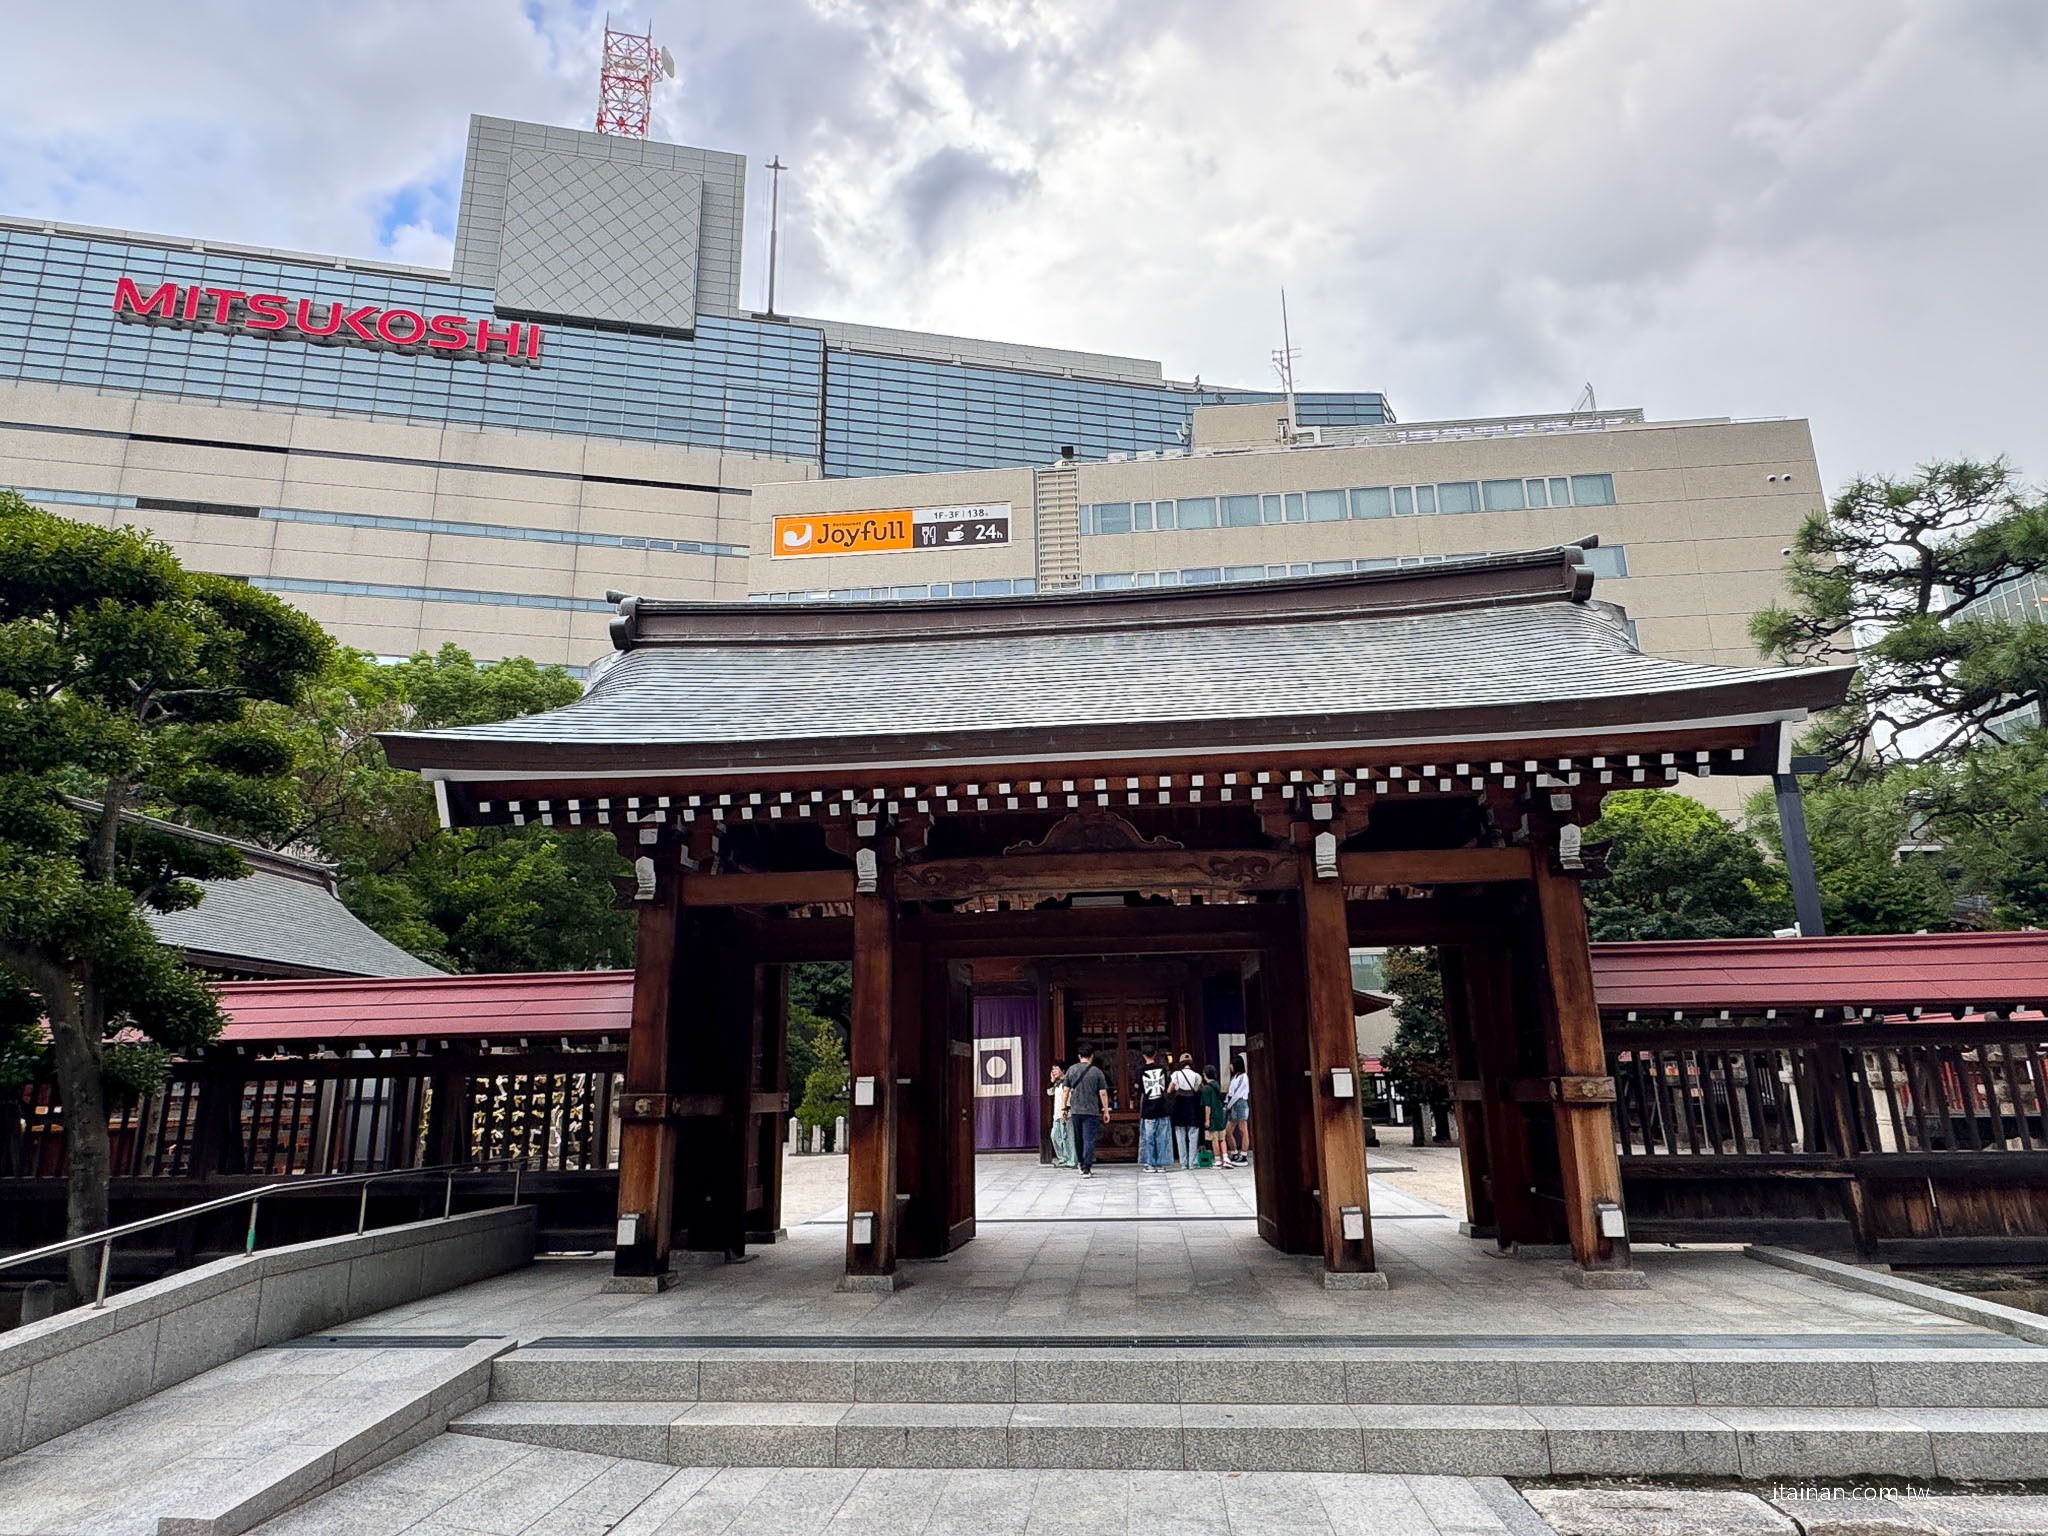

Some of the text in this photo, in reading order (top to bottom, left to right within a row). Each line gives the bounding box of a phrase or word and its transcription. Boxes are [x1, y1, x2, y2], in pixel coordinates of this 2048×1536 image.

[112, 276, 541, 359] MITSUKOSHI
[934, 511, 960, 519] 1F-3F
[817, 520, 905, 547] Joyfull
[975, 523, 1003, 540] 24h
